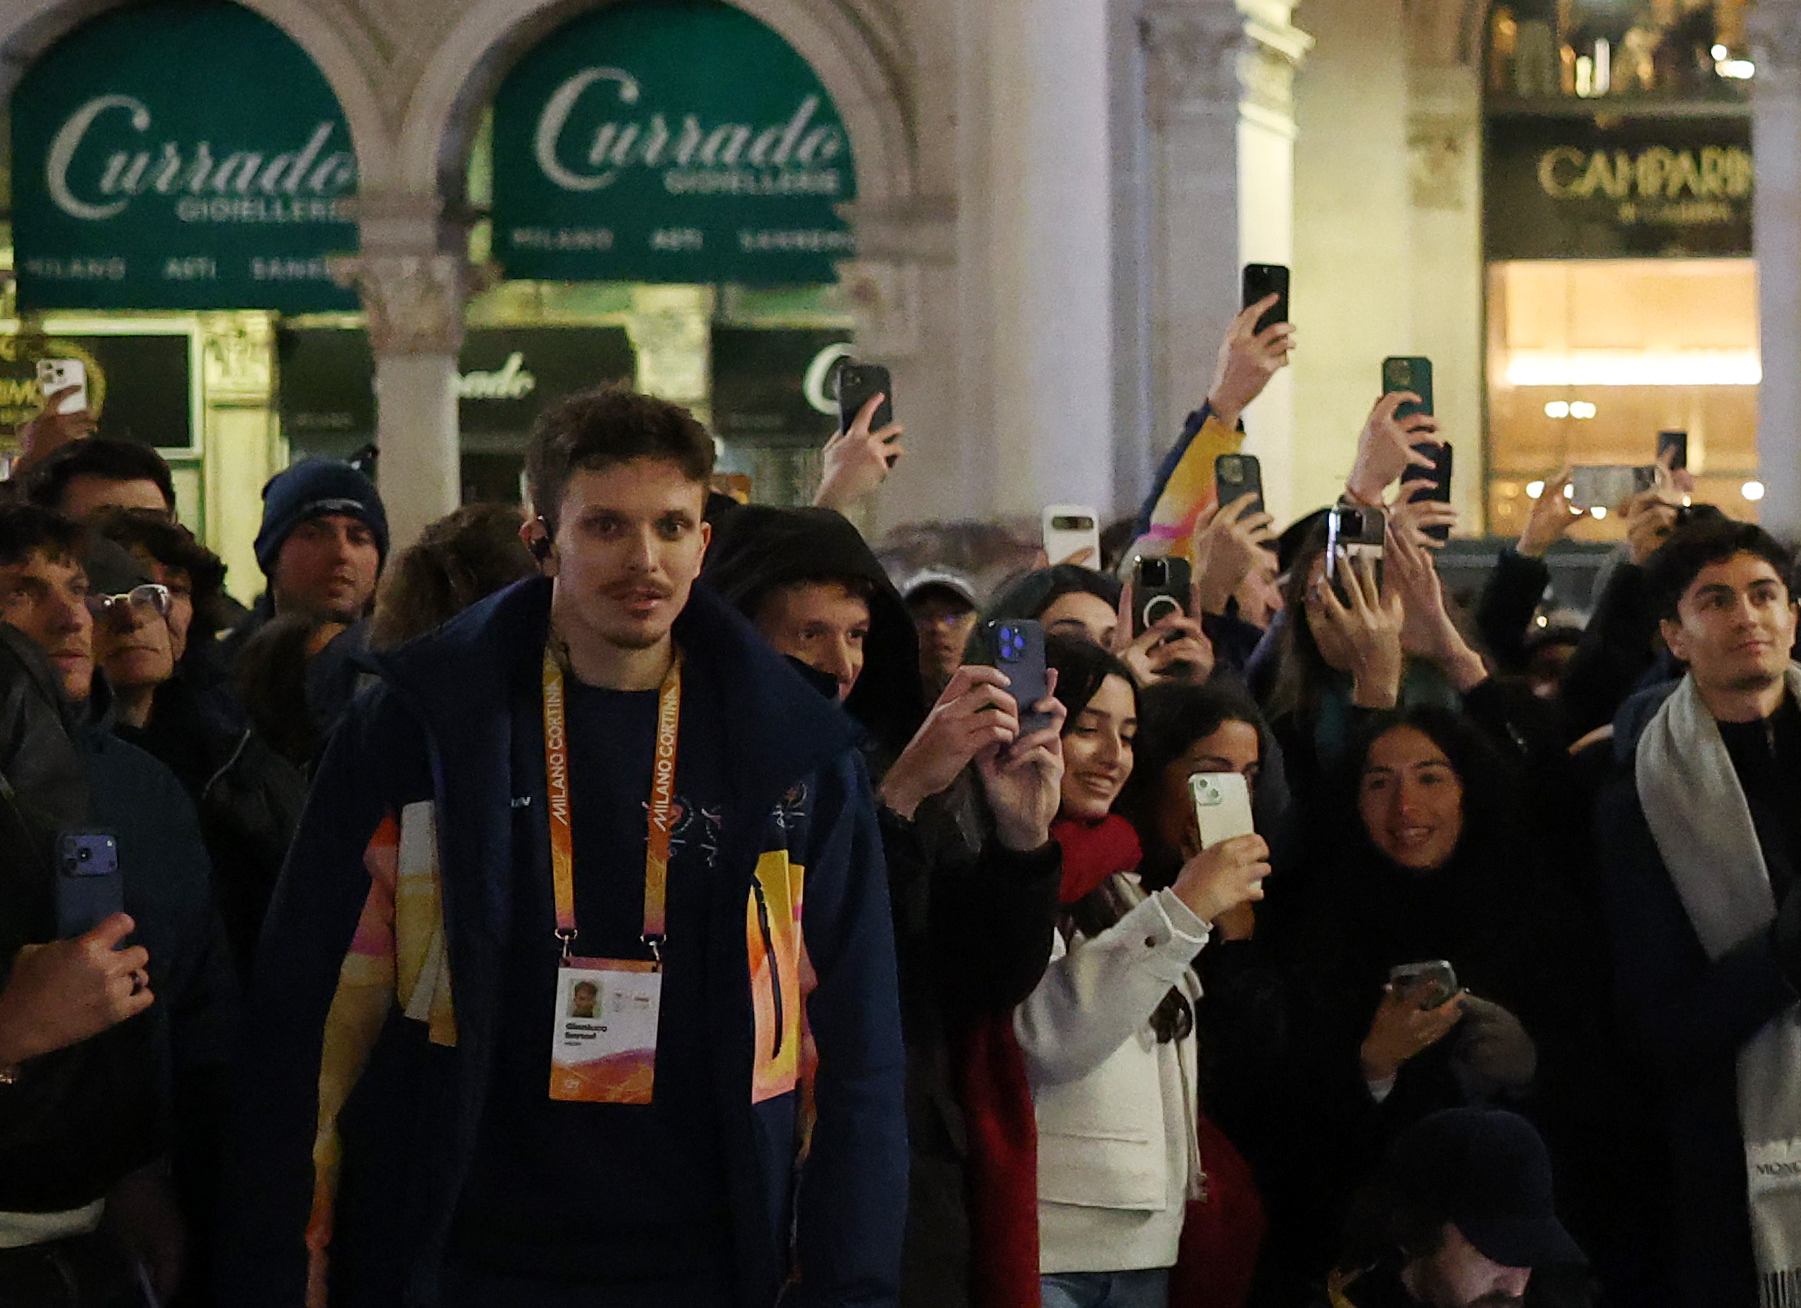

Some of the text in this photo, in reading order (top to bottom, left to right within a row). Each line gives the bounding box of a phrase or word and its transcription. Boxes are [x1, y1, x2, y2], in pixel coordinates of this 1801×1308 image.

[48, 94, 352, 219] Currado
[534, 66, 842, 190] Currado
[546, 678, 569, 827] MILANO CORTINA
[653, 686, 678, 833] MILANO CORTINA
